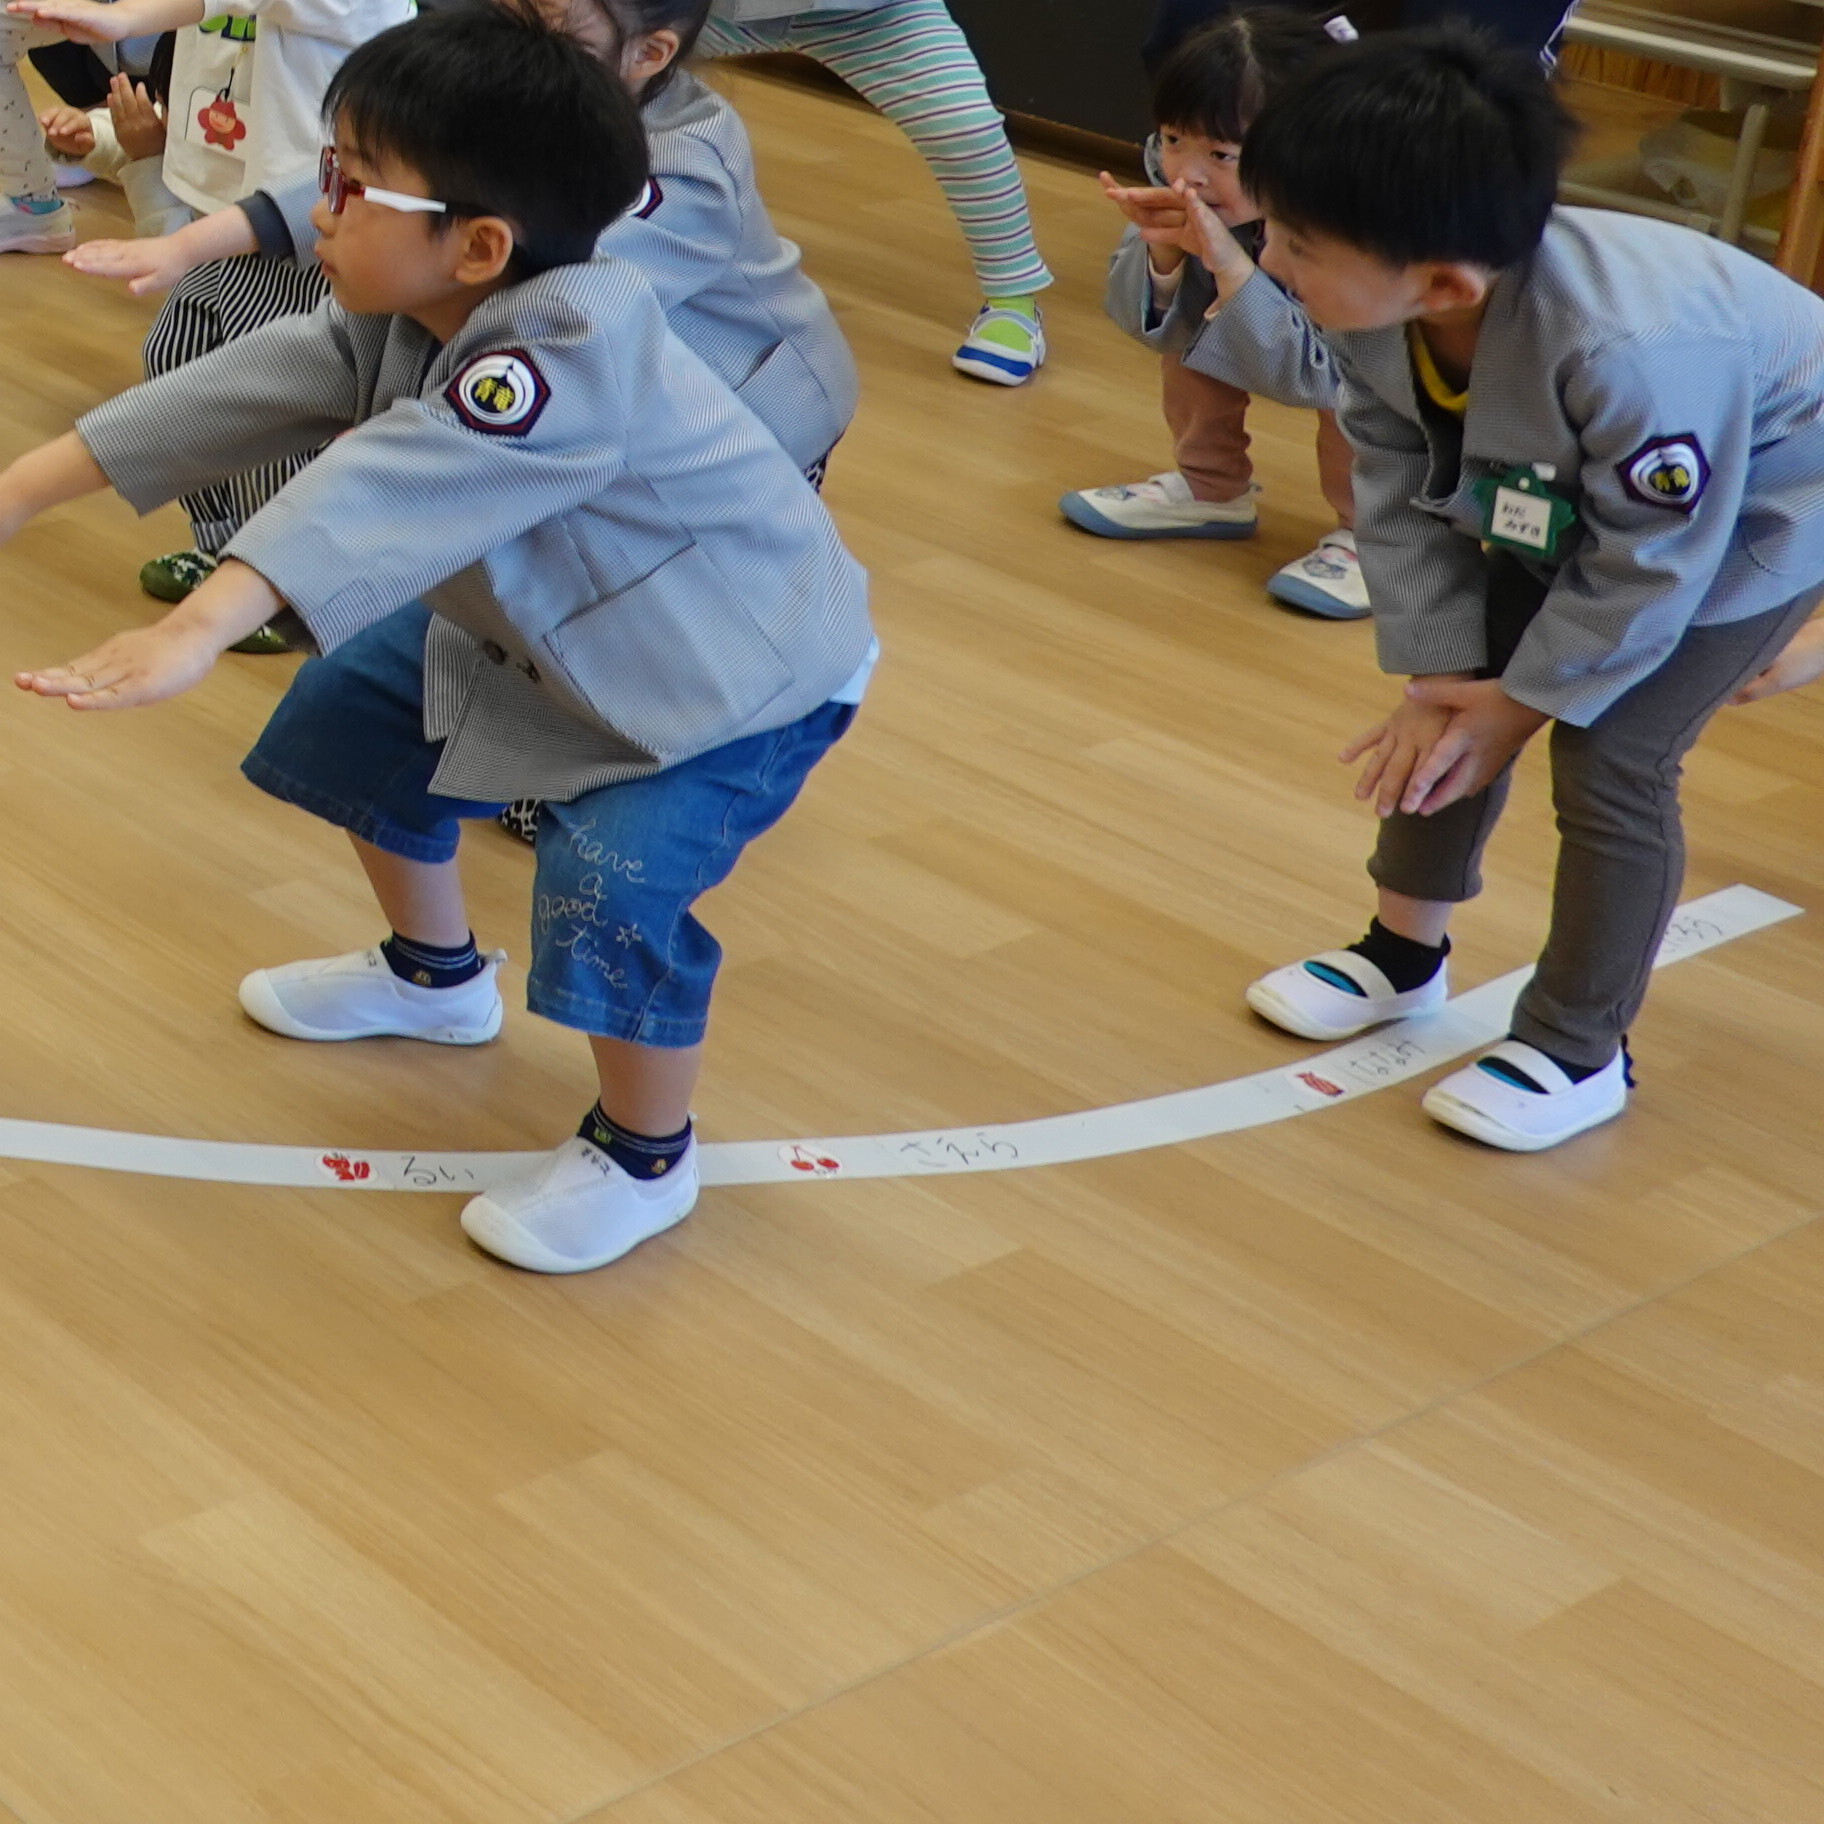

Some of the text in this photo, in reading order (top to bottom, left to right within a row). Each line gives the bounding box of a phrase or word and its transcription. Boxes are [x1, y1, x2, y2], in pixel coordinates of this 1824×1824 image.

[567, 818, 646, 884] have
[538, 893, 609, 935] good
[555, 923, 628, 990] time
[399, 1155, 475, 1186] るい
